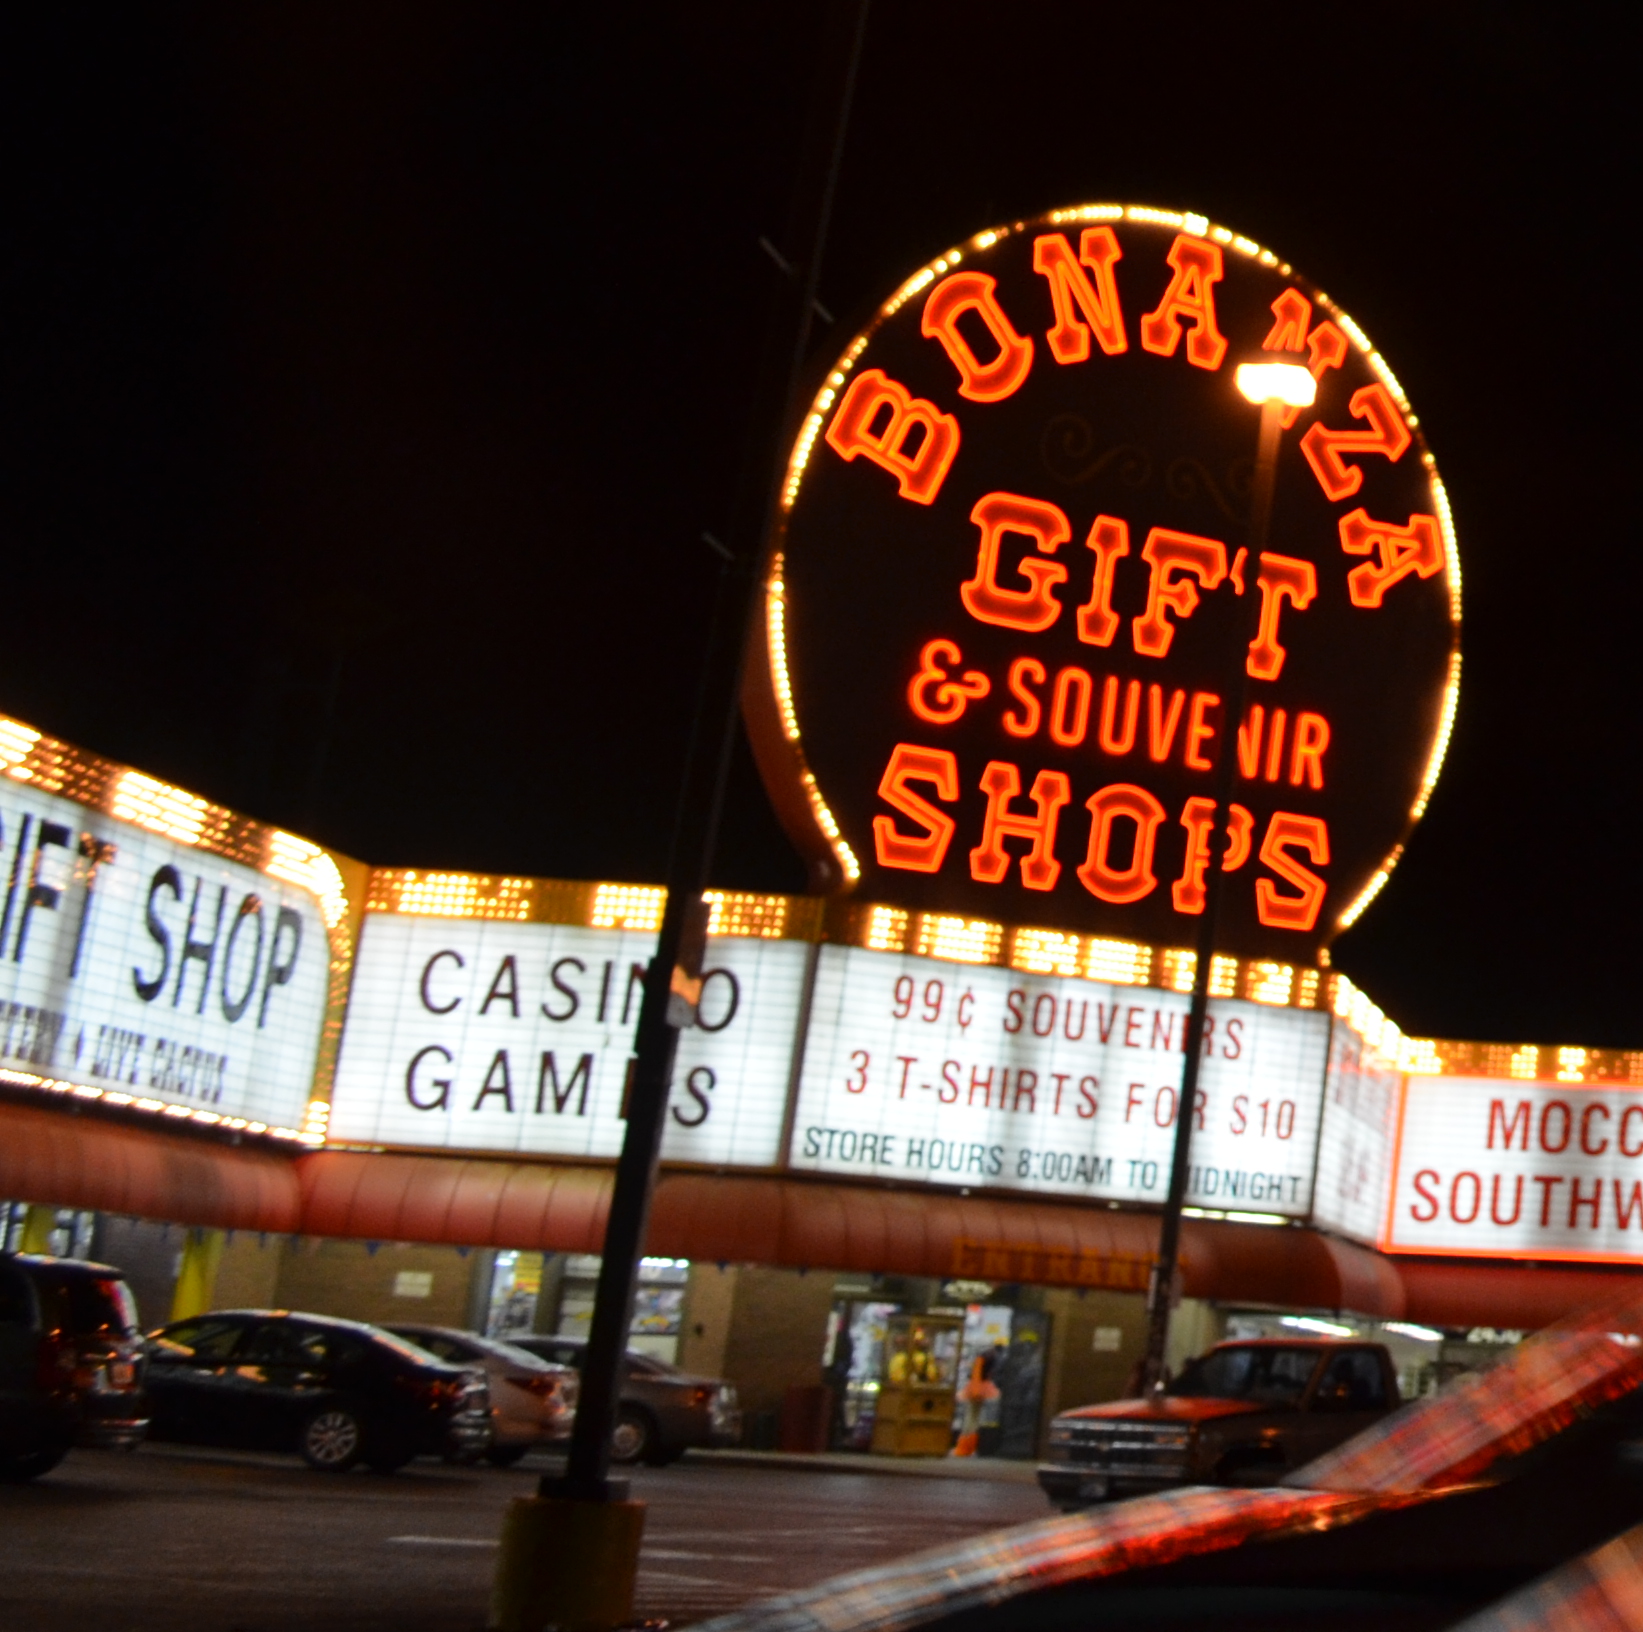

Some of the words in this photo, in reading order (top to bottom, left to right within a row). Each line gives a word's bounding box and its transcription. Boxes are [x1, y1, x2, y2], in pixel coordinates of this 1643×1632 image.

[825, 226, 1447, 608] BONANZA
[960, 491, 1317, 681] GIFT
[906, 639, 991, 724] &
[1003, 658, 1330, 790] SOUVENIR
[872, 742, 1330, 932] SHOPS
[0, 808, 118, 980] IFT
[132, 862, 304, 1030] SHOP
[419, 949, 741, 1033] CASINO
[804, 1126, 895, 1166] STORE
[905, 1137, 1004, 1176] HOURS
[1016, 1147, 1113, 1188] 8:00AM
[1128, 1158, 1158, 1190] TO
[1188, 1164, 1304, 1204] IDNIGHT
[846, 1050, 871, 1094] 3
[896, 1056, 1100, 1119] T-SHIRTS
[1124, 1082, 1208, 1132] FOR
[952, 1236, 1190, 1293] ENTRANC
